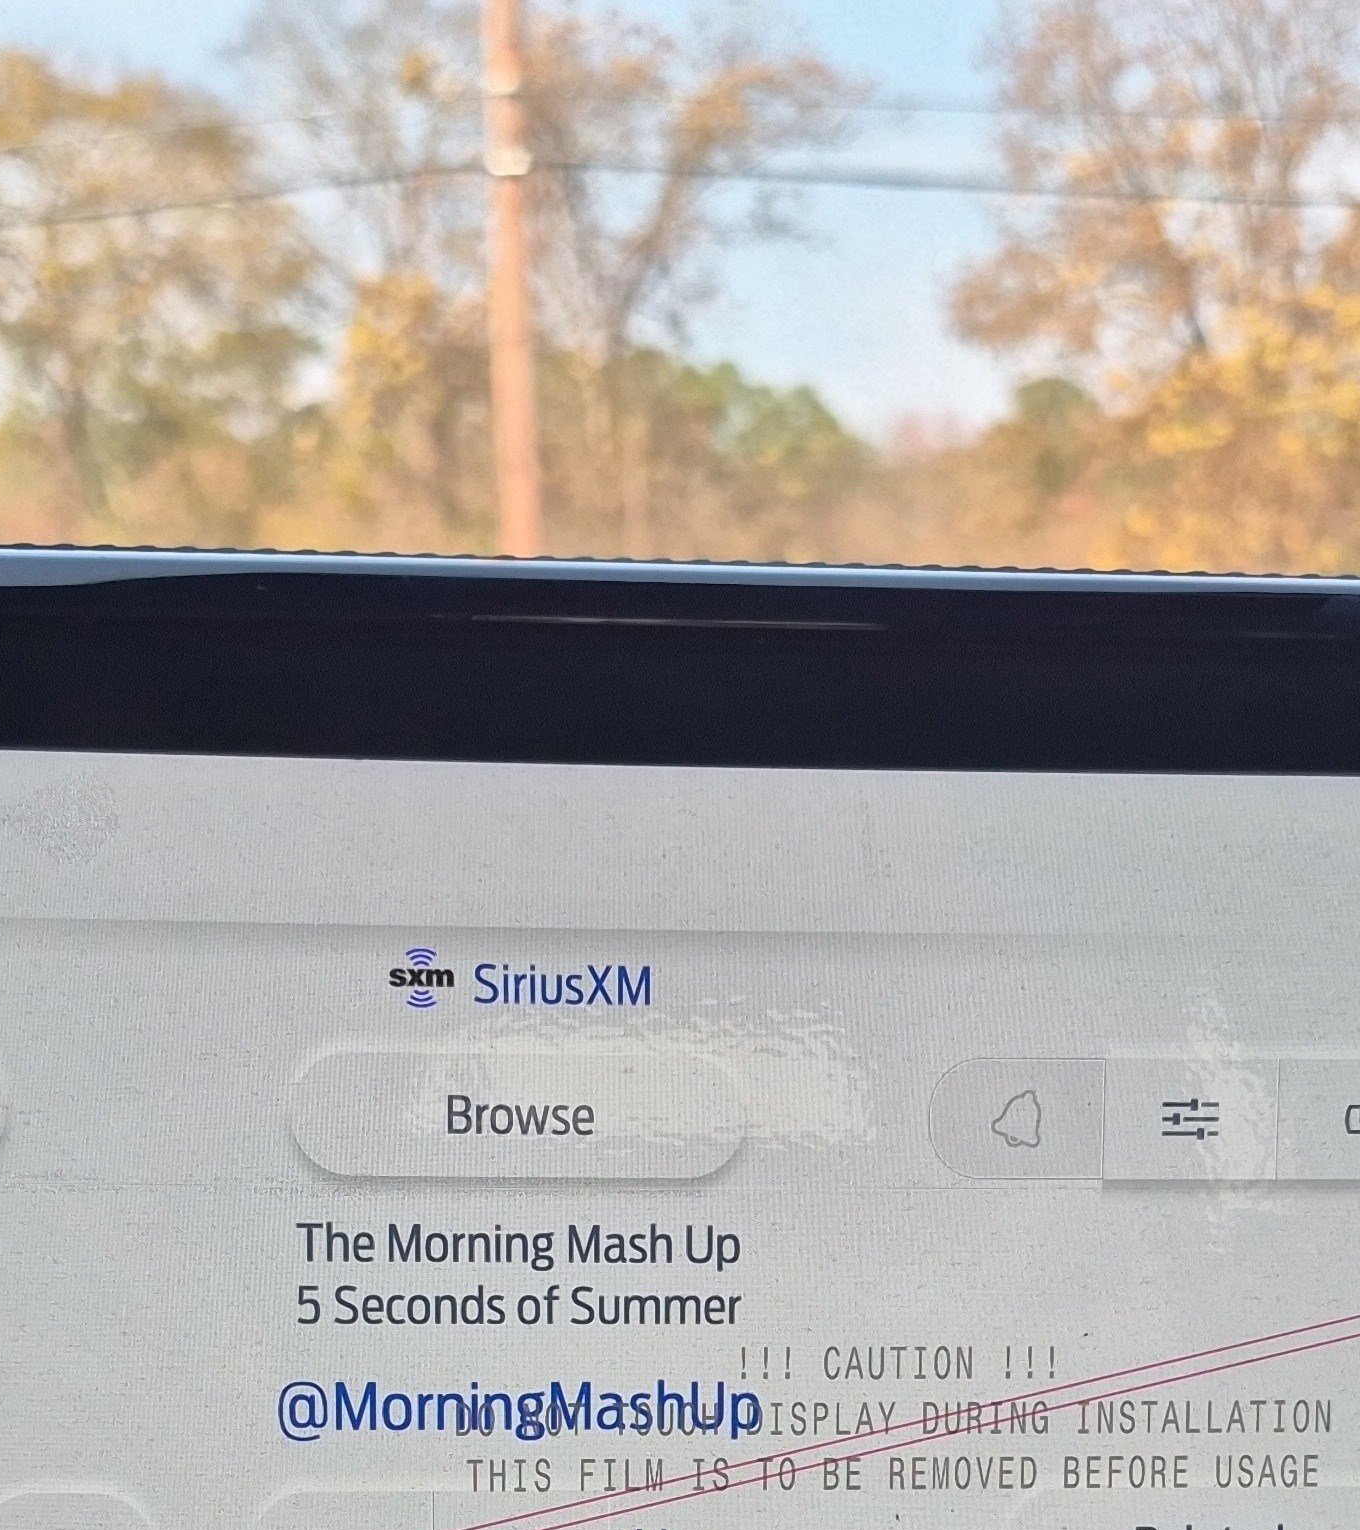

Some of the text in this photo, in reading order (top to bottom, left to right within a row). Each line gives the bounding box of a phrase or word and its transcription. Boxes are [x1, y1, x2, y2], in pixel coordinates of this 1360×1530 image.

[389, 966, 455, 988] sxm
[473, 963, 652, 1006] SiriusXM
[445, 1094, 596, 1137] Browse
[296, 1222, 741, 1273] The Morning Mash Up
[297, 1285, 741, 1327] 5 Seconds of Summer
[739, 1346, 1058, 1381] !!! CAUTION !!!
[278, 1379, 761, 1442] @MorningMashUp
[455, 1399, 1332, 1437] DO NOT TOUCH DISPLAY DURING INSTALLATION
[466, 1454, 1321, 1493] THIS FILM IS TO BE REMOVED BEFORE USAGE
